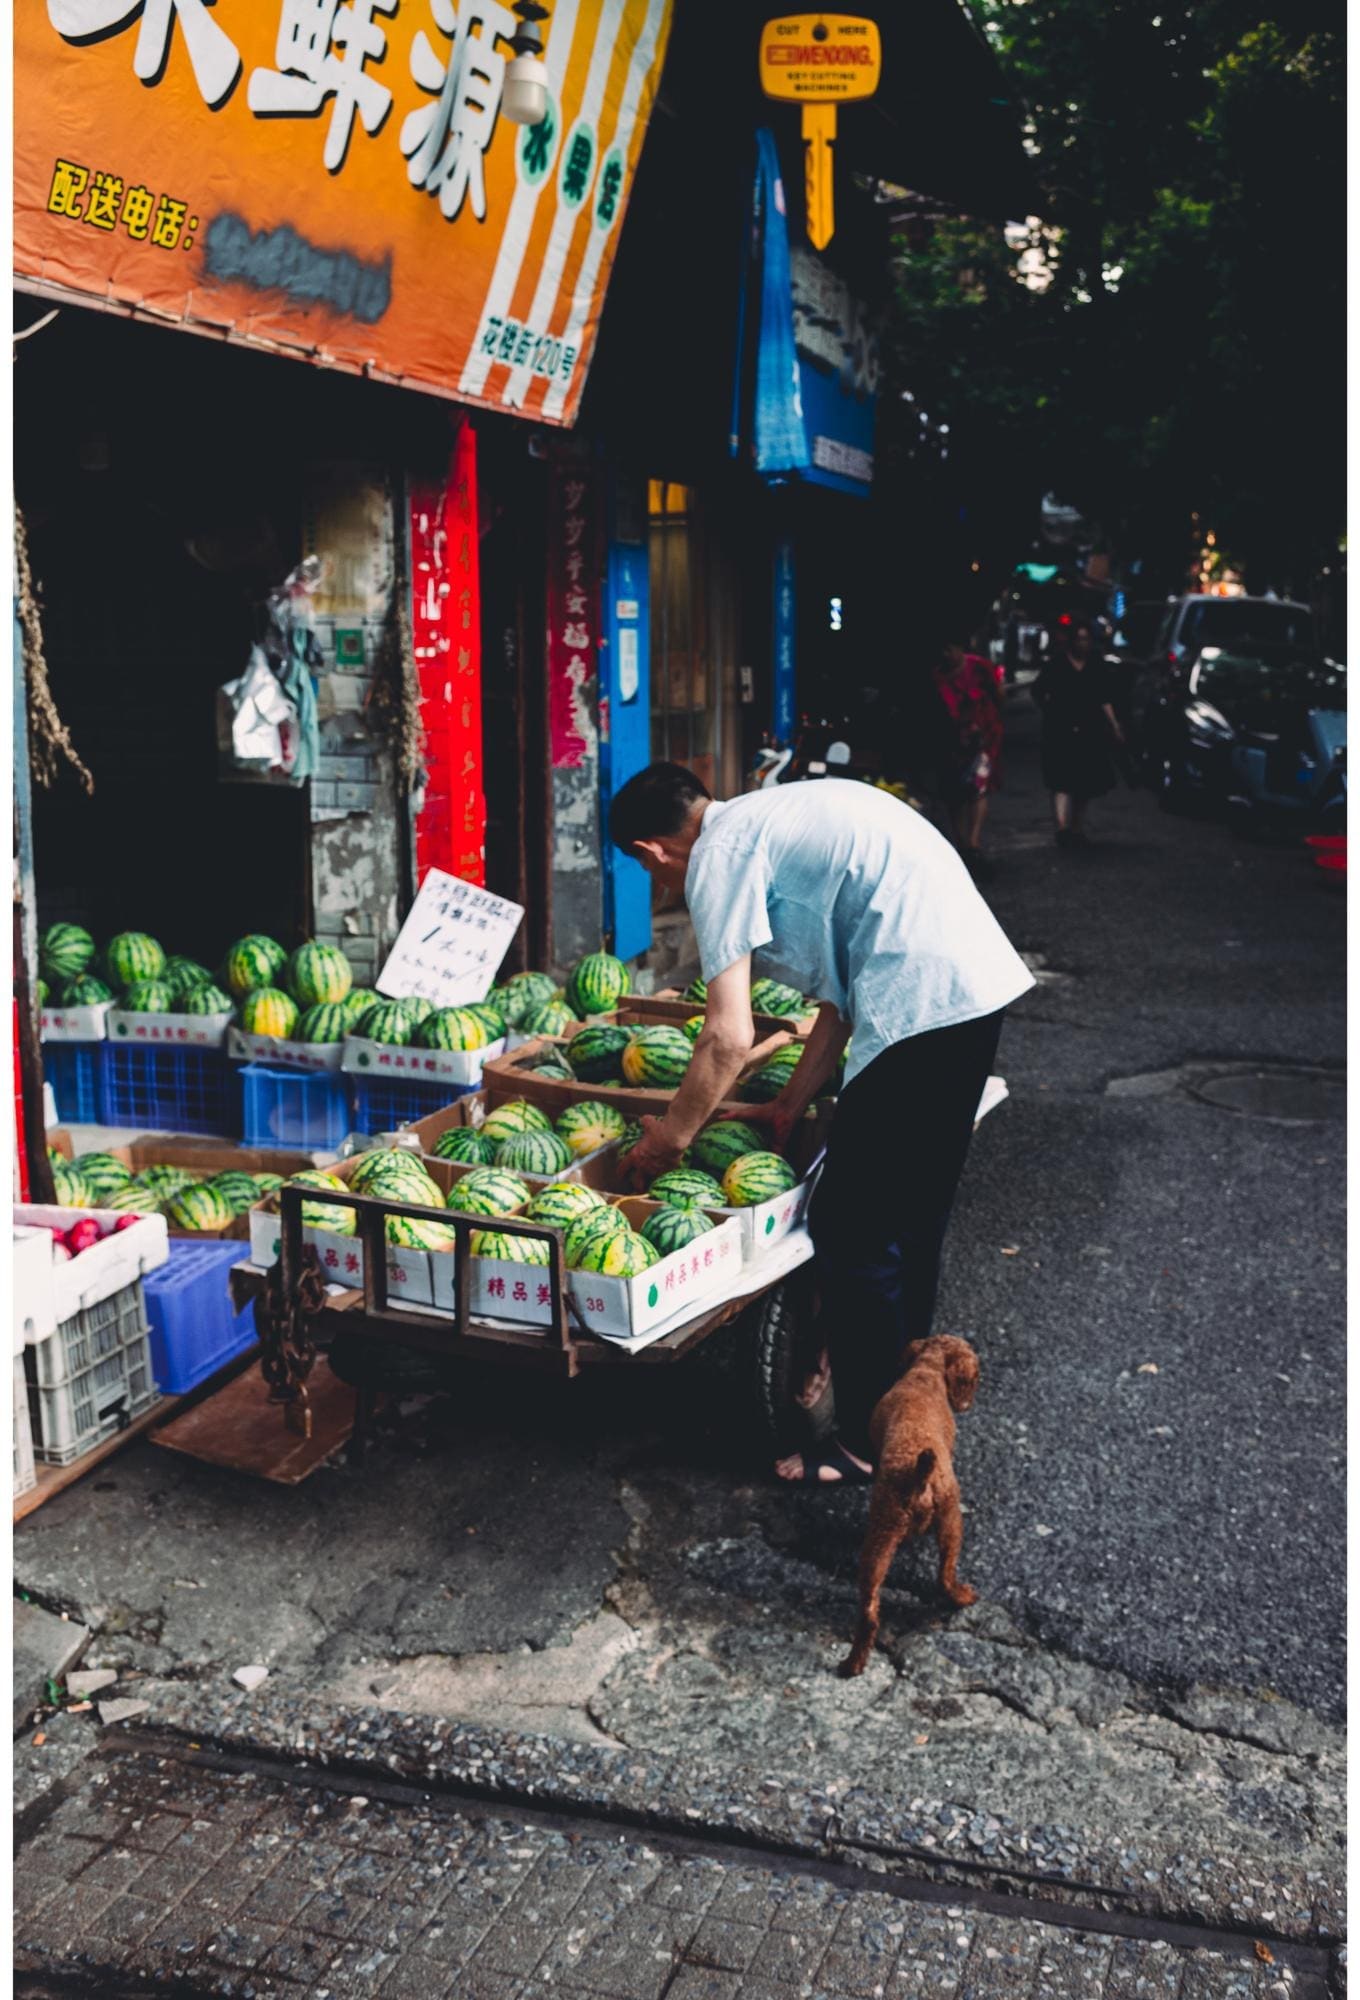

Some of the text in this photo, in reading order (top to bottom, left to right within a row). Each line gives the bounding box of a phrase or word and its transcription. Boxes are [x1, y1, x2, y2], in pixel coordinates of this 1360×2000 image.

[776, 25, 867, 36] CUT HERE
[794, 84, 848, 93] MACHINES
[586, 1297, 605, 1313] 38
